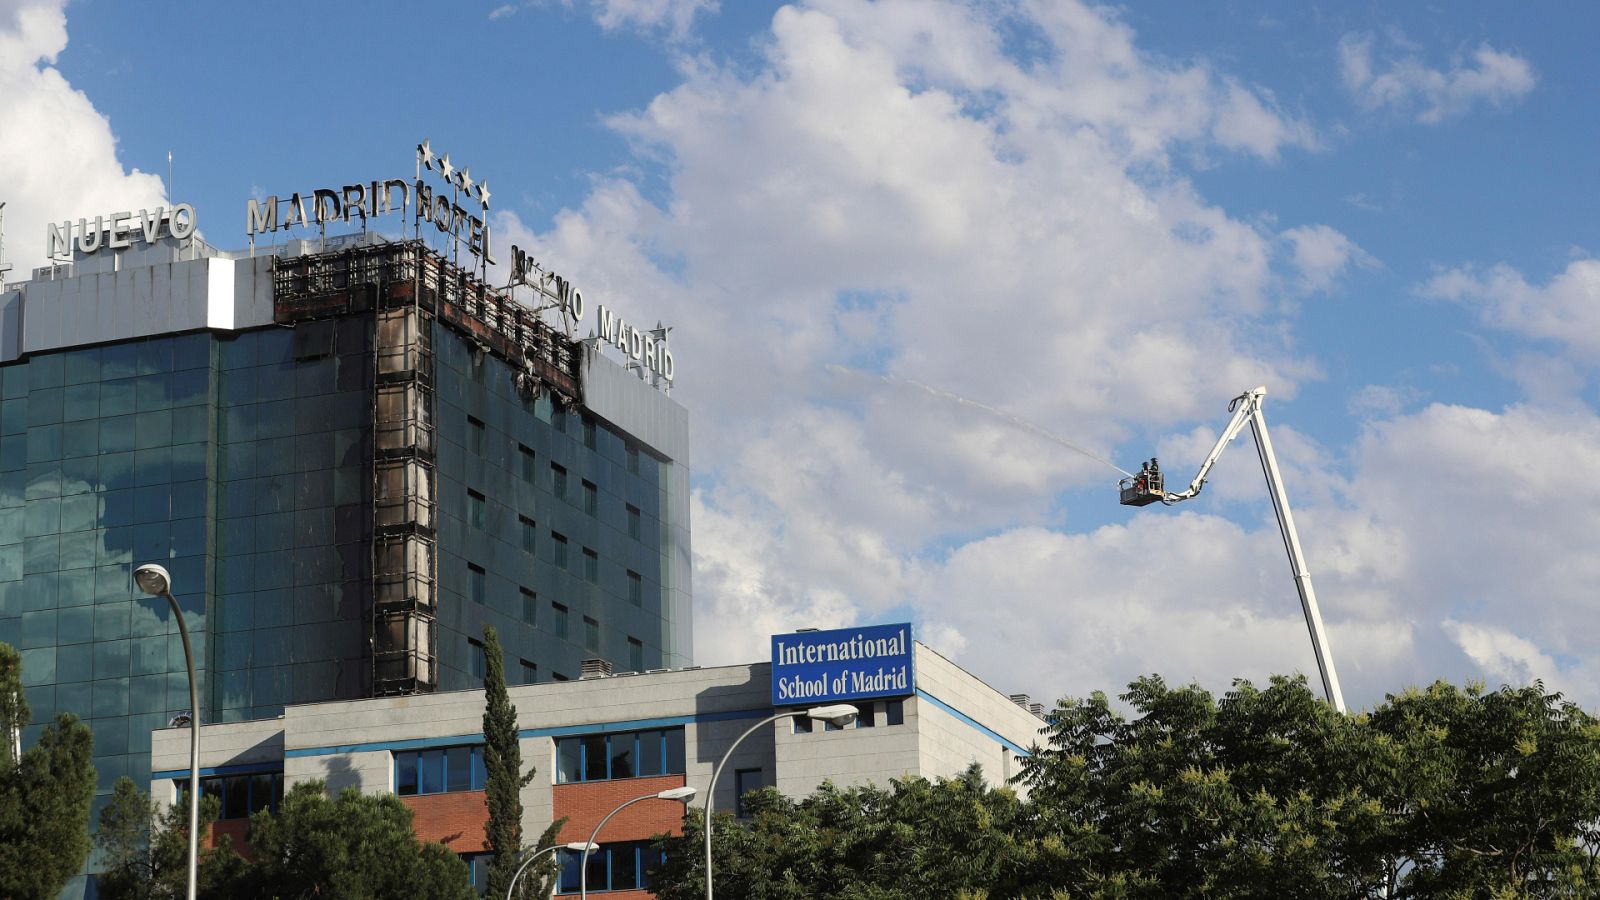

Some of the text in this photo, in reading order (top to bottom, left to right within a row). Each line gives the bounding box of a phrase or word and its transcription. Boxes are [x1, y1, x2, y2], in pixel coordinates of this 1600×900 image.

[47, 203, 197, 259] NUEVO
[247, 179, 410, 235] MADRID
[416, 179, 674, 381] HOTEL NVO MADRID
[777, 629, 906, 666] International
[779, 665, 907, 700] School of Madrid
